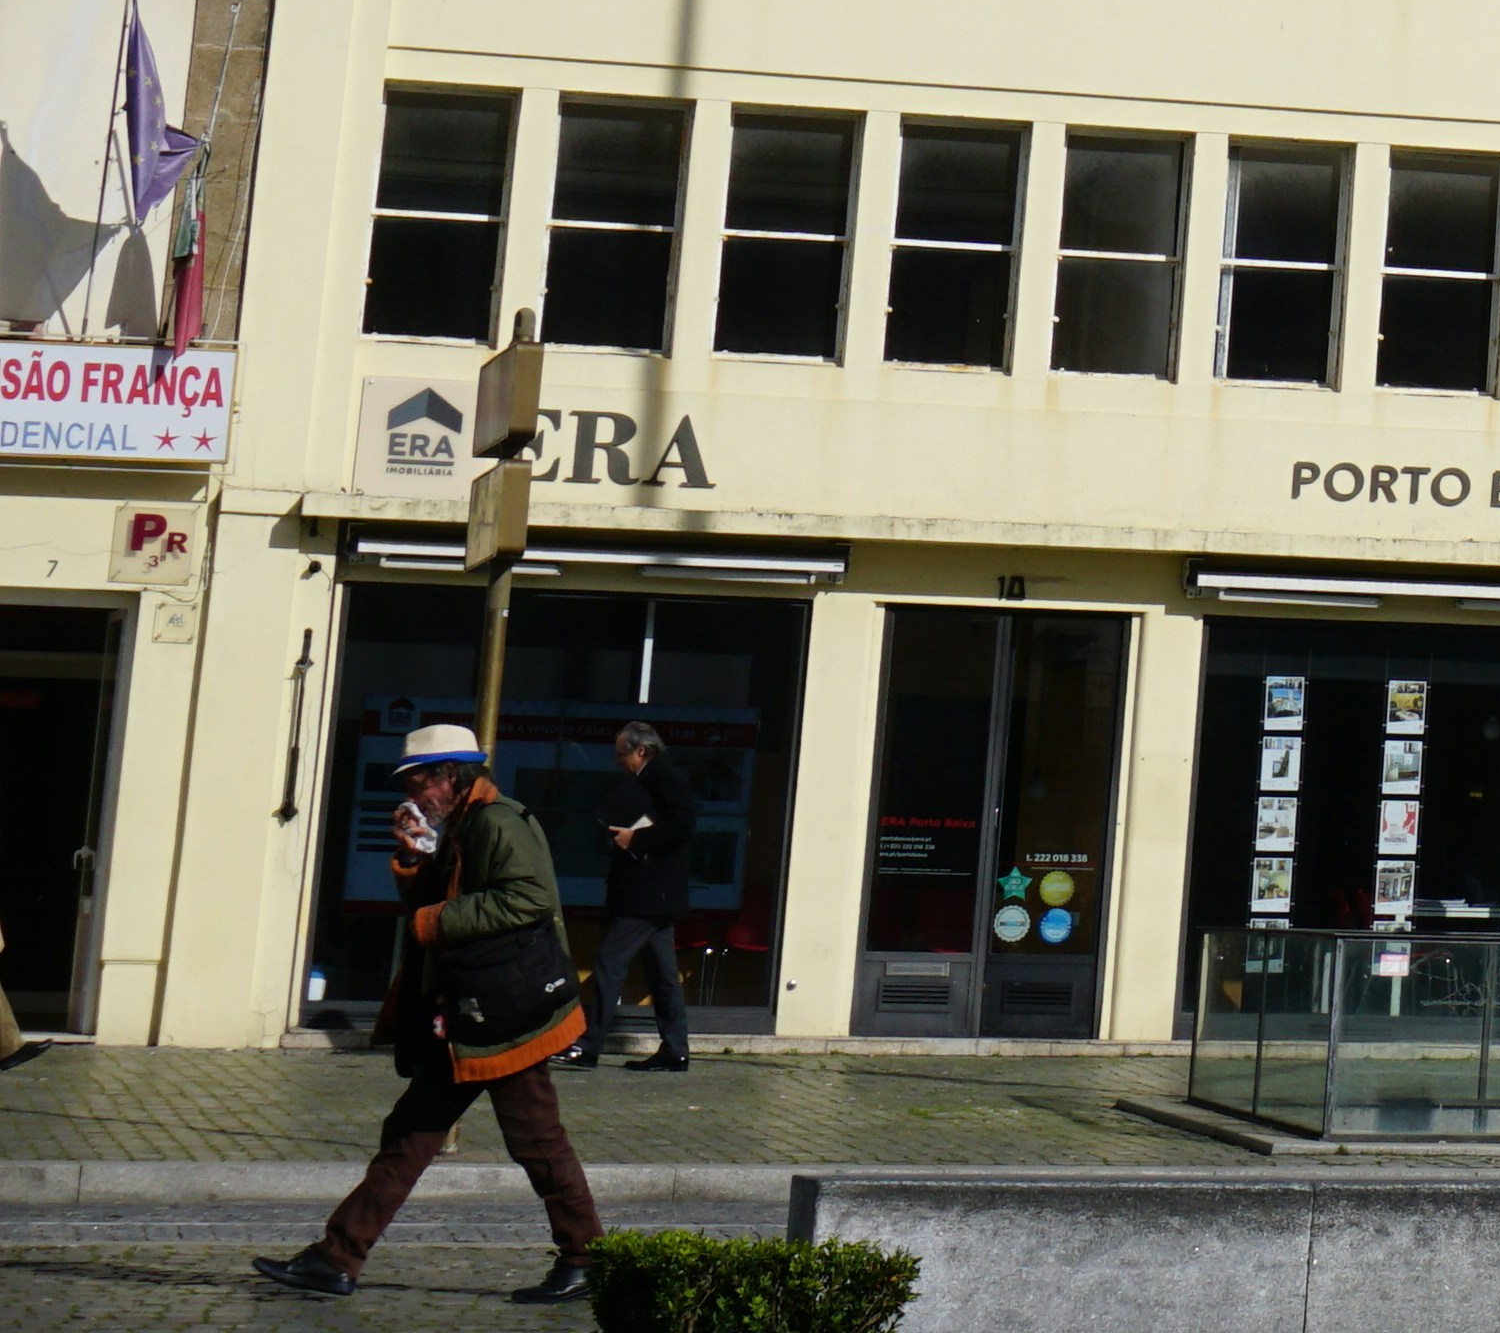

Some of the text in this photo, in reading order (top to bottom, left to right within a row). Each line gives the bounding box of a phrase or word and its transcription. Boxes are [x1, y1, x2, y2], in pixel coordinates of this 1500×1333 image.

[0, 350, 224, 418] SÃO FRANÇA
[0, 420, 138, 452] DENCIAL
[388, 433, 455, 459] ERA
[519, 409, 717, 489] ERA
[385, 464, 454, 478] IMOBILIÁRIA
[1291, 461, 1471, 507] PORTO
[46, 559, 59, 579] 7
[880, 816, 905, 827] ERA
[909, 817, 941, 828] Porto
[1033, 853, 1052, 862] 222
[1052, 853, 1069, 862] 018
[1070, 854, 1089, 863] 338
